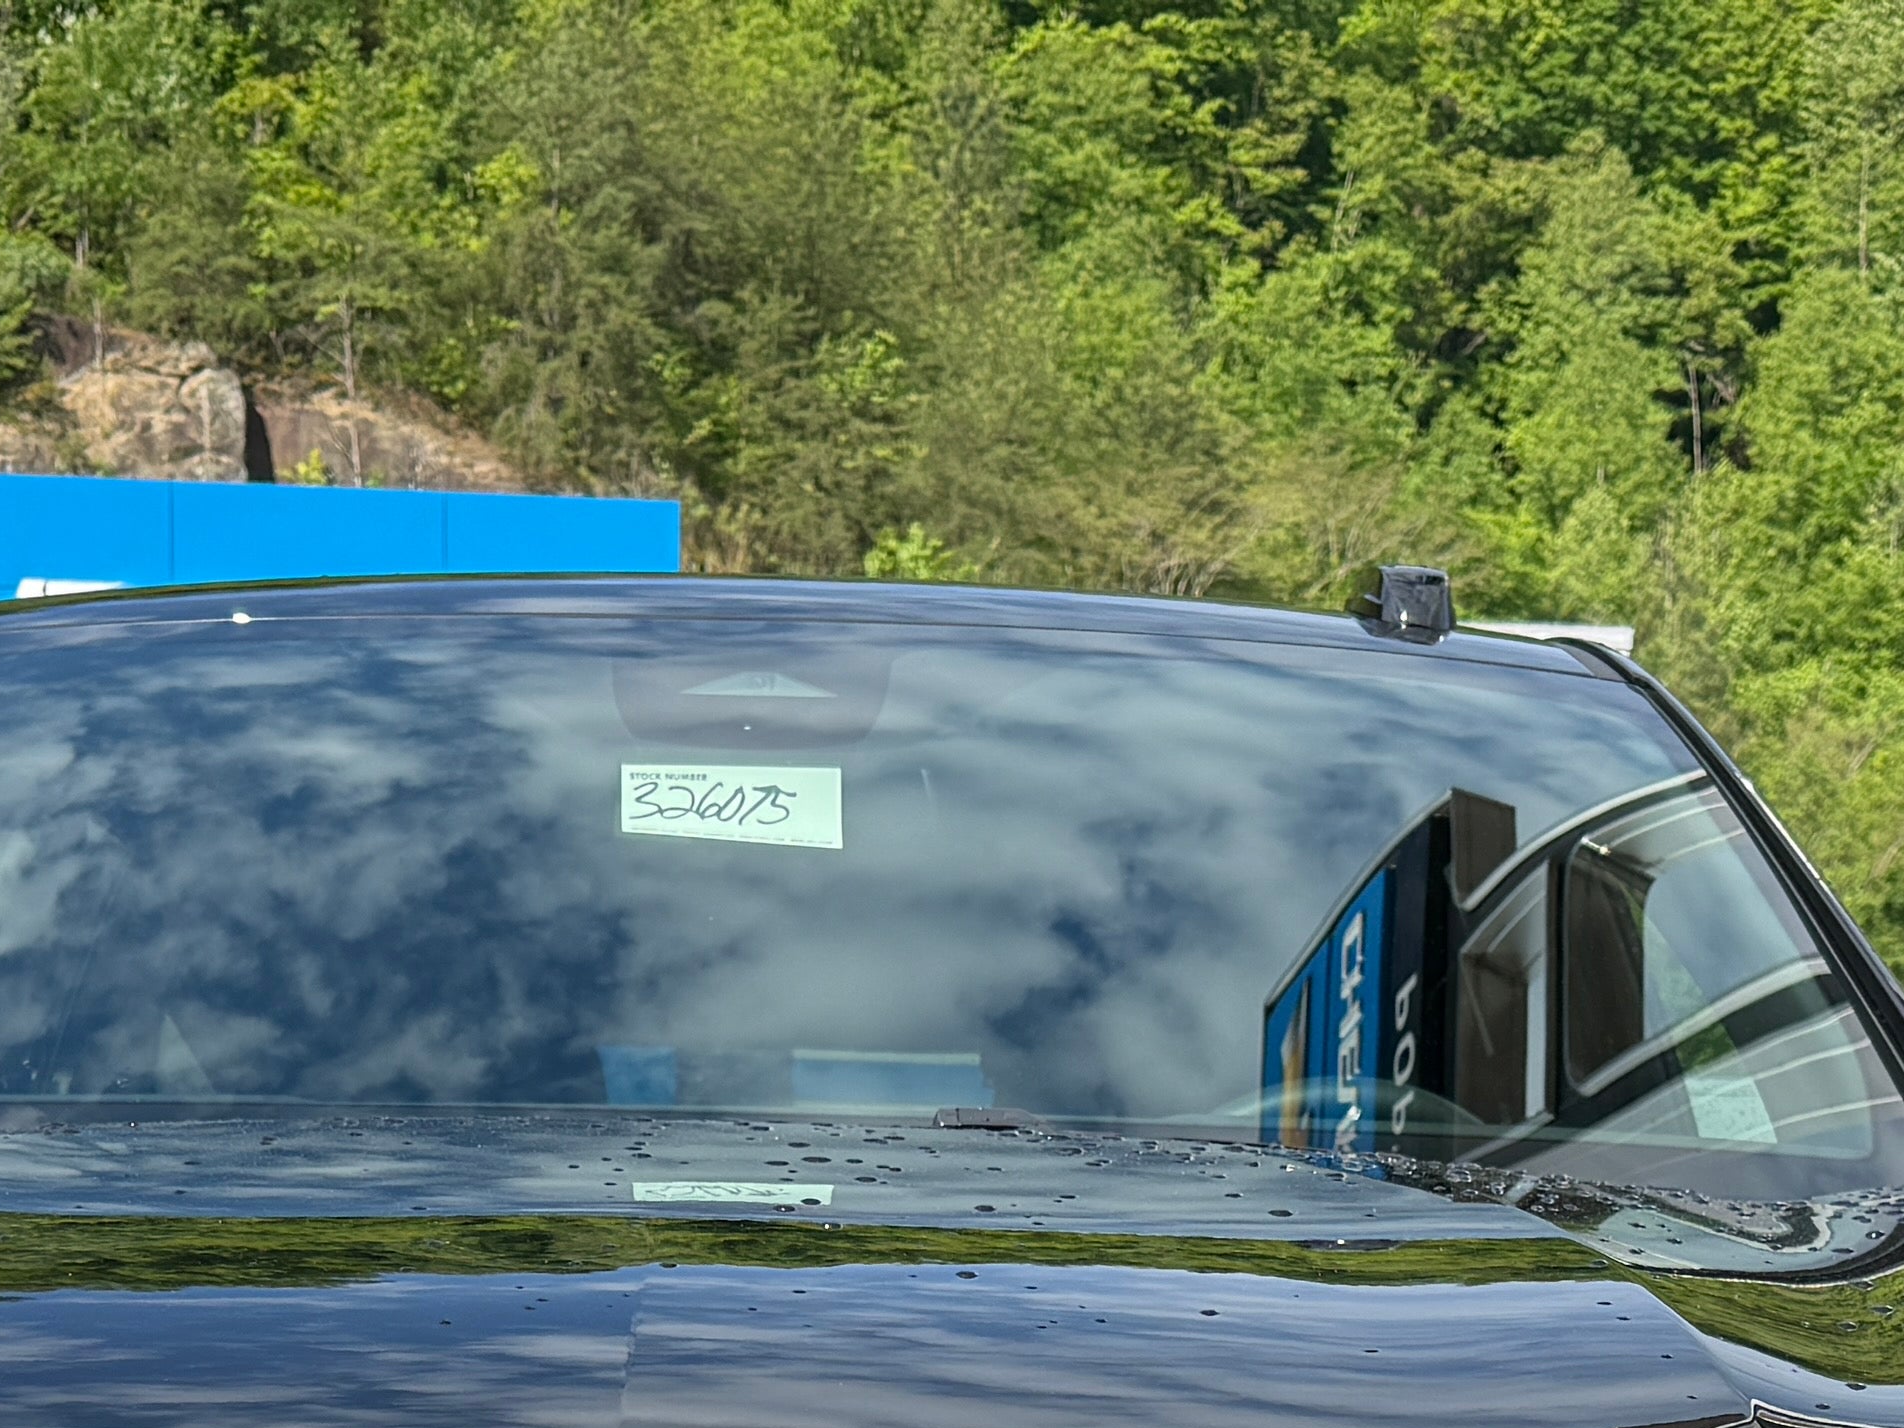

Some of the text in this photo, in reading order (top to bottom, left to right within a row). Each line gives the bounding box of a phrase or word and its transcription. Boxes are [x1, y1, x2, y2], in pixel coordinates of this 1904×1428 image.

[629, 772, 707, 781] STOCK NUMBER
[629, 782, 796, 825] 326075
